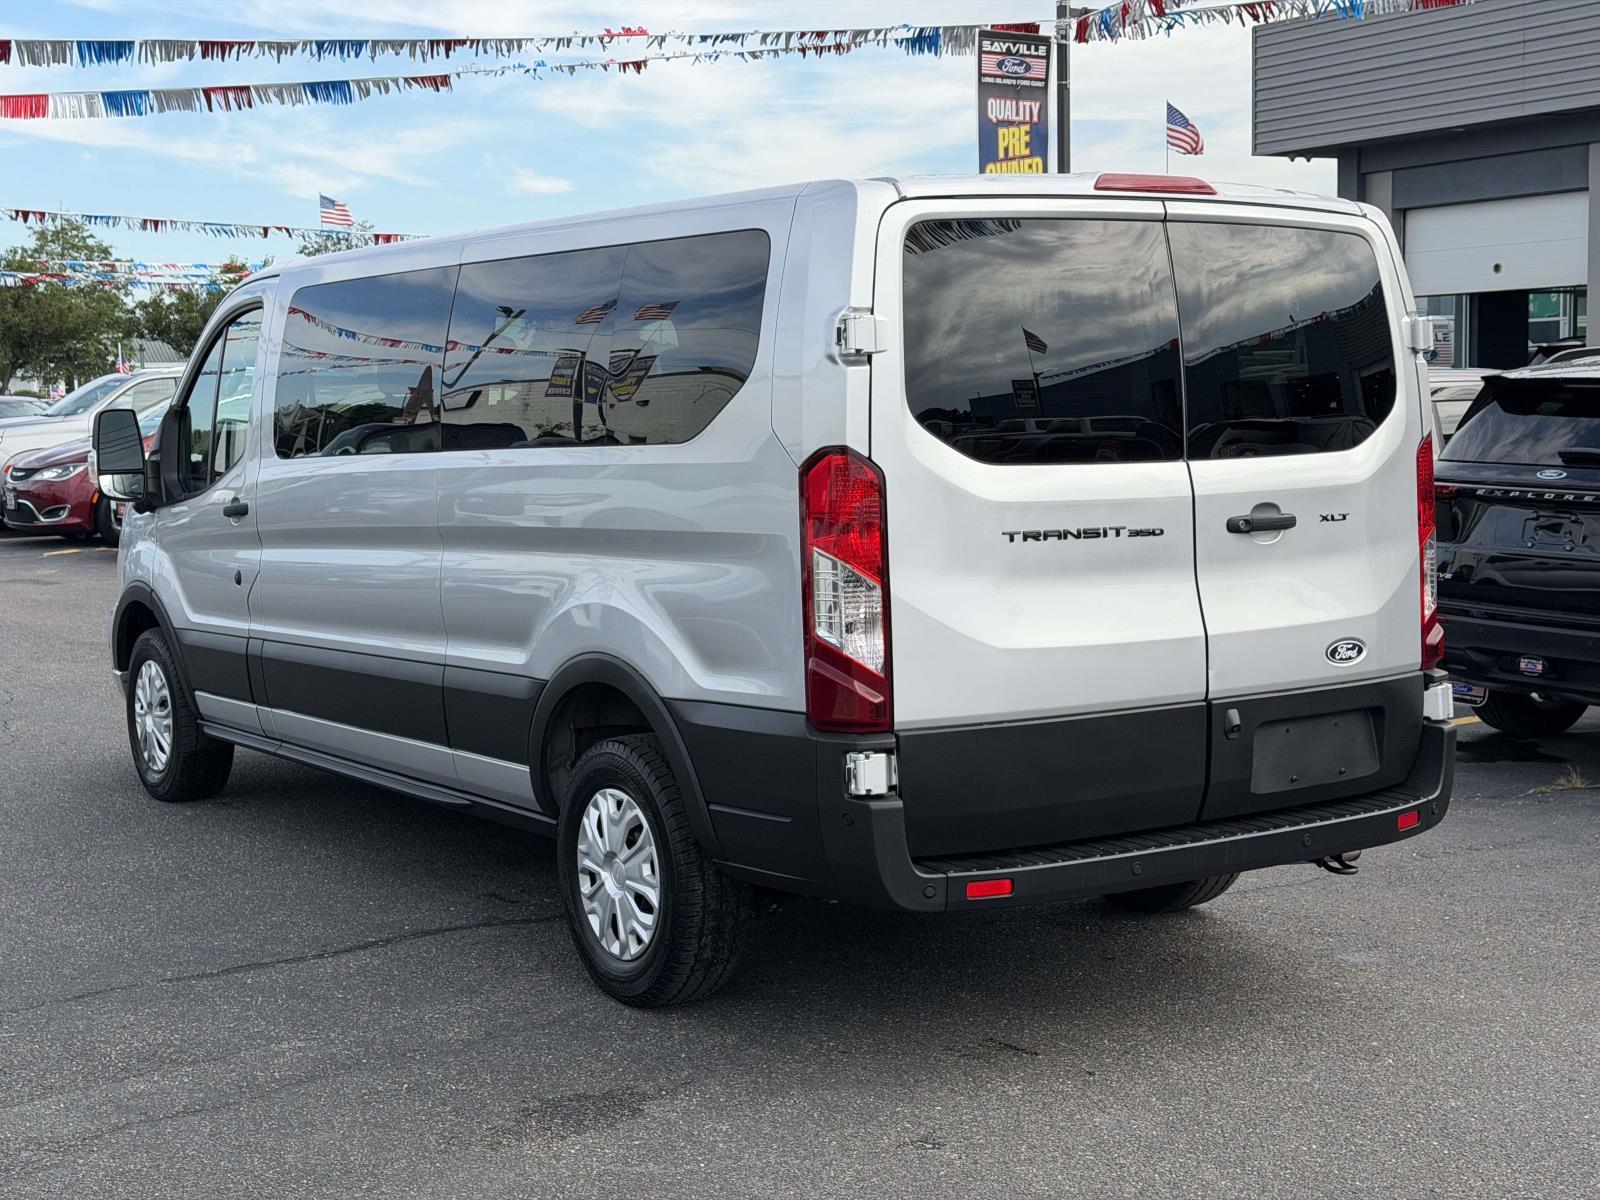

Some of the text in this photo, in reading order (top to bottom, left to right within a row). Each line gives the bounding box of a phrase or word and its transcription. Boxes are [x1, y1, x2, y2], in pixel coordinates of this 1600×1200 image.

[982, 40, 1047, 56] SAYVILLE
[1001, 58, 1026, 74] Ford
[987, 97, 1041, 123] QUALITY
[998, 124, 1031, 160] PRE
[1318, 513, 1350, 523] XLT
[1001, 525, 1165, 543] TRANSIT 350
[1335, 643, 1359, 660] Ford
